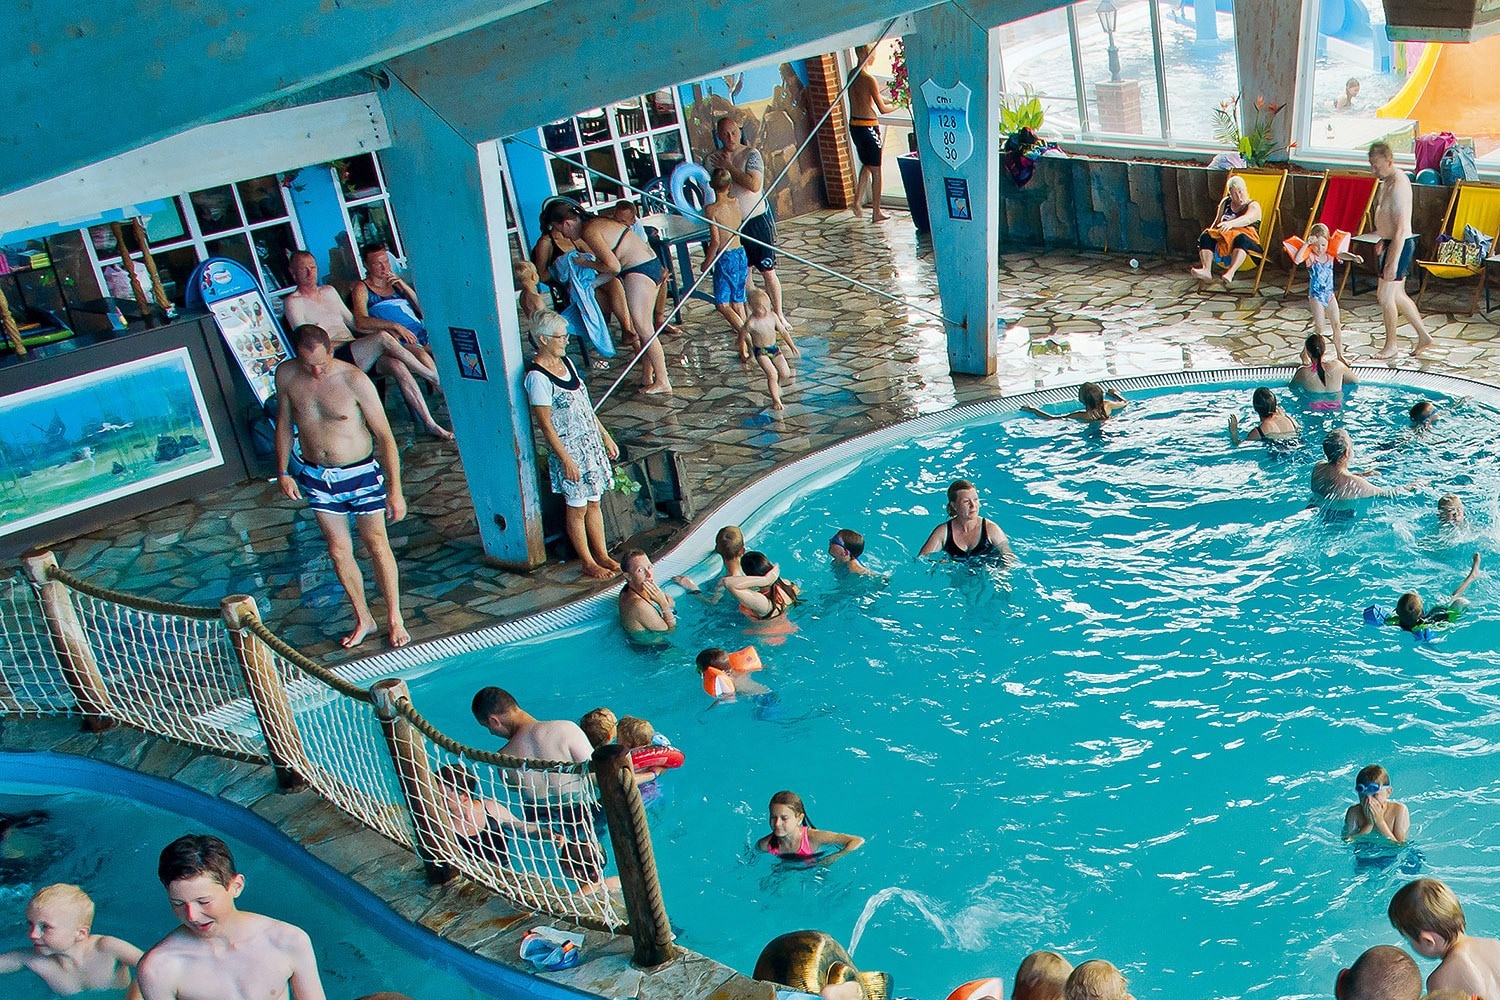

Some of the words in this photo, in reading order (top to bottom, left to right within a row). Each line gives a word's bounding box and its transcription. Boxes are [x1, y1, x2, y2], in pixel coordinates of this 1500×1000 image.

[938, 114, 957, 129] 128
[943, 131, 956, 146] 80
[945, 147, 958, 161] 30
